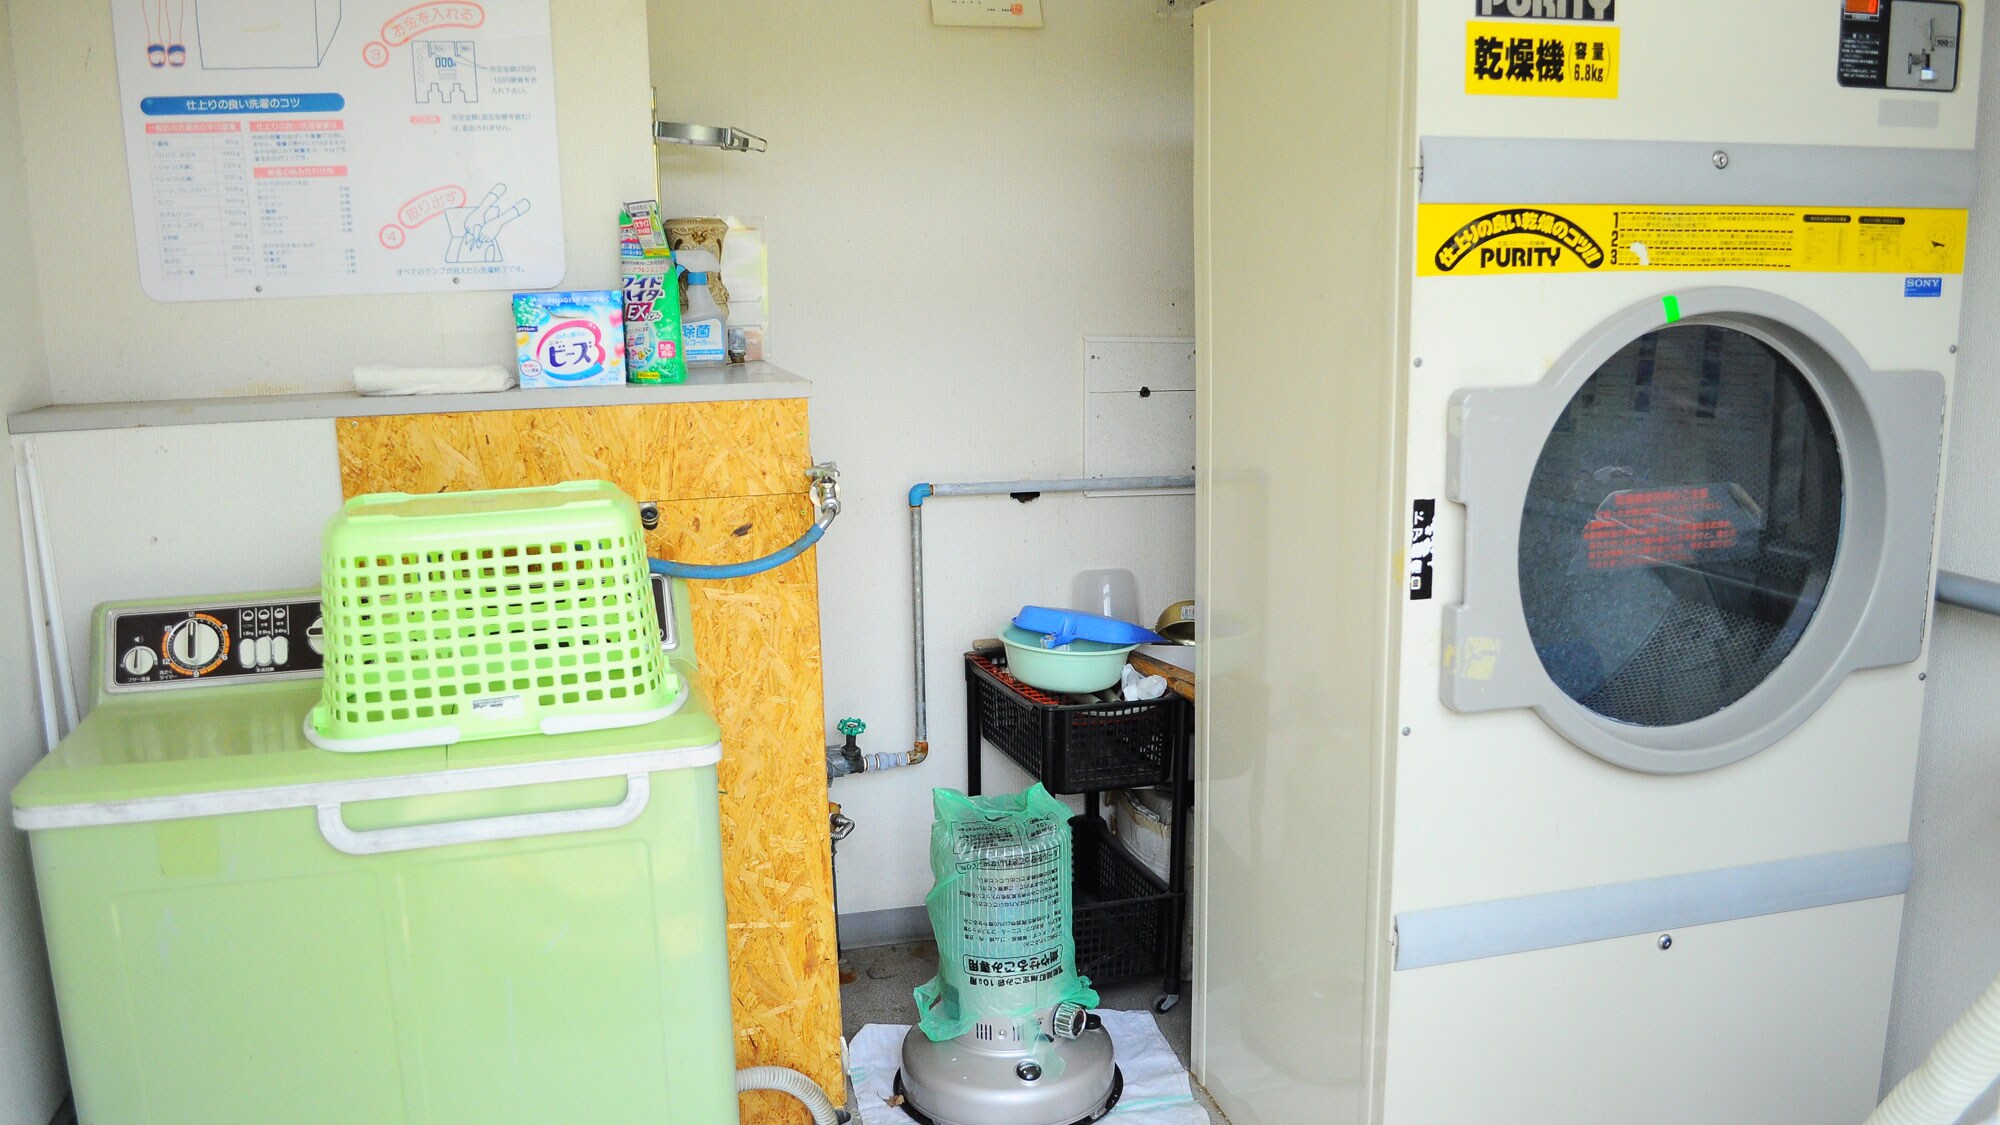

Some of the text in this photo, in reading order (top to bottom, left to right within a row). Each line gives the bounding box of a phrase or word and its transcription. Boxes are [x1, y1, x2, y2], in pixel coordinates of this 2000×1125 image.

[391, 8, 473, 37] お金を入れる
[371, 49, 381, 60] 3
[1474, 36, 1565, 83] 乾燥機
[1575, 42, 1604, 60] 容量
[1574, 64, 1603, 82] 6.8kg
[186, 98, 301, 110] 仕上りの良い洗濯のコツ
[404, 191, 458, 221] 取り出す
[386, 231, 397, 241] 4
[1611, 230, 1618, 247] 2
[1481, 247, 1561, 268] PURITY
[1610, 249, 1617, 265] 3
[1907, 279, 1940, 287] SONY
[682, 325, 711, 338] 除菌
[549, 341, 592, 367] ビーズ
[968, 949, 1059, 973] 燃やせるごみ専用
